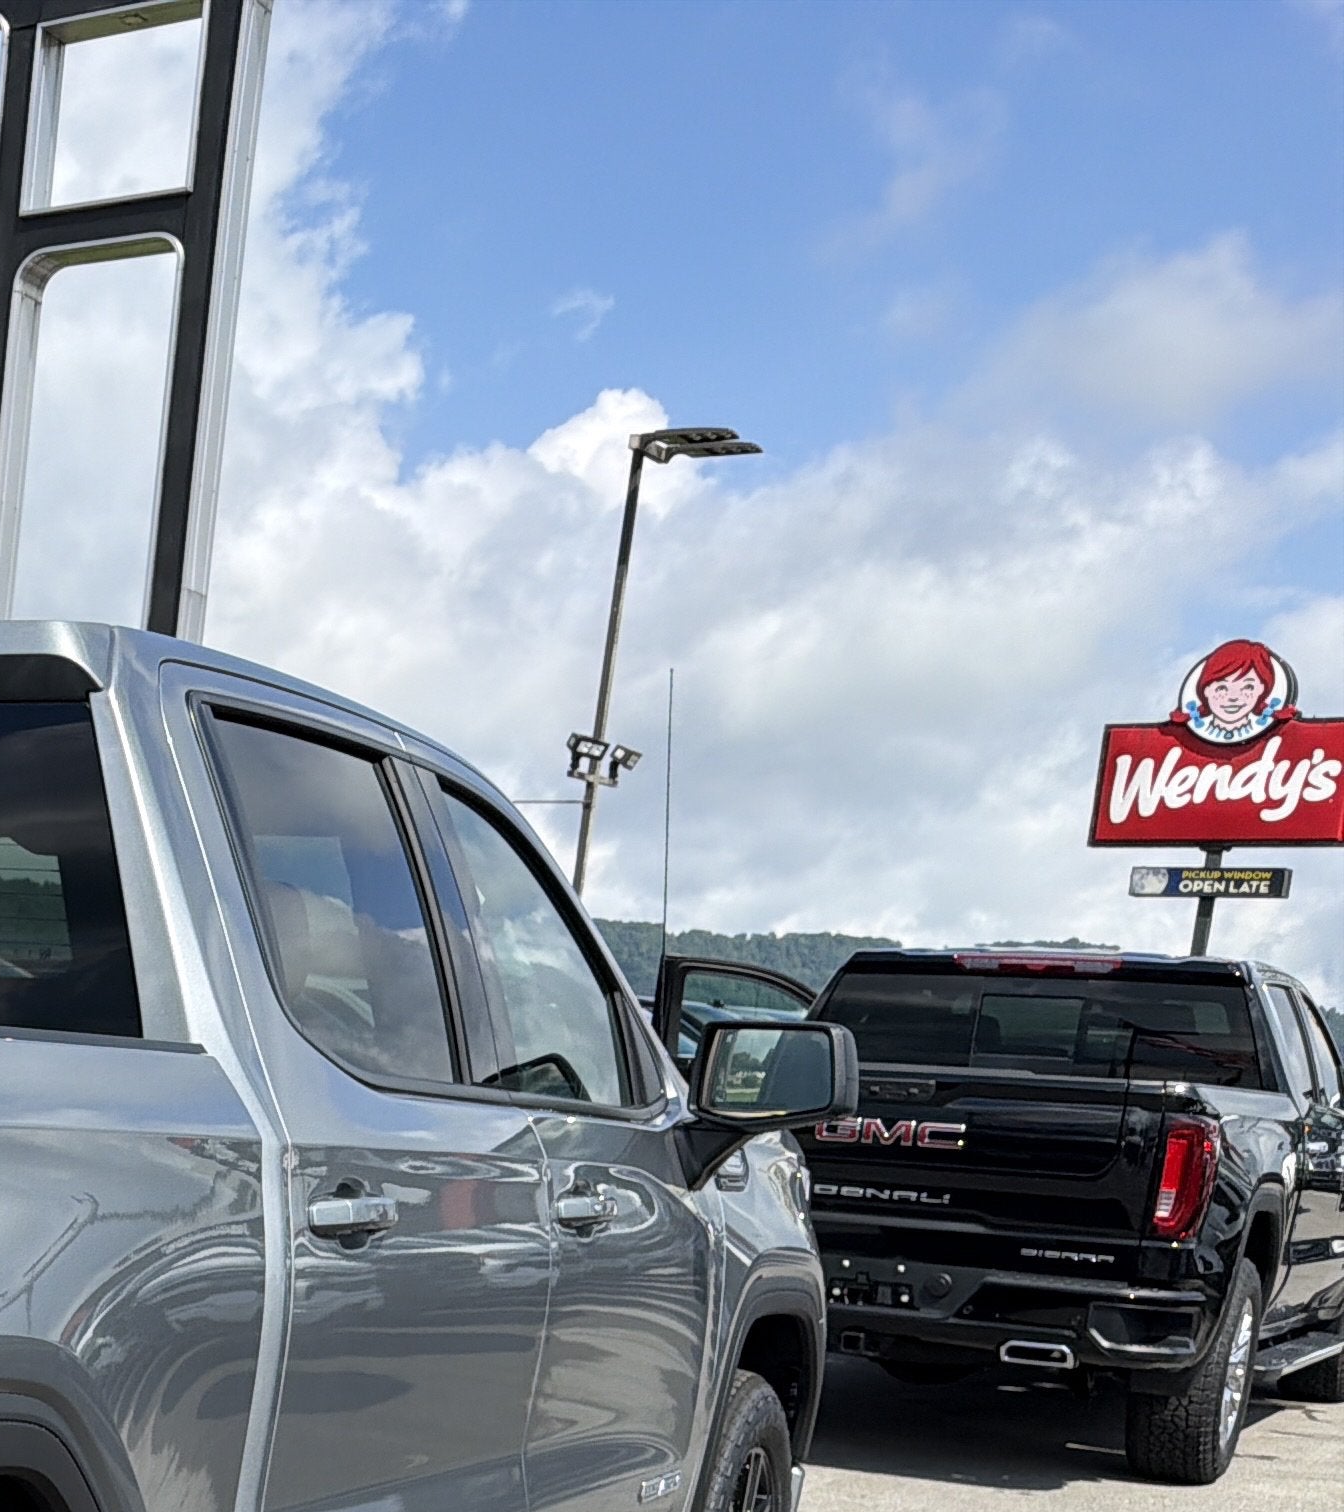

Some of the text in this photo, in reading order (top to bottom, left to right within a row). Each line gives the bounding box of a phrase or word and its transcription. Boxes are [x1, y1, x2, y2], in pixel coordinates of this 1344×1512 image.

[1109, 735, 1342, 825] Wendy's
[1181, 870, 1273, 880] PICKUP WINDOW
[1178, 880, 1271, 895] OPEN LATE
[814, 1114, 967, 1151] GMC
[813, 1183, 951, 1205] DENALI
[1020, 1247, 1116, 1264] SIERRA
